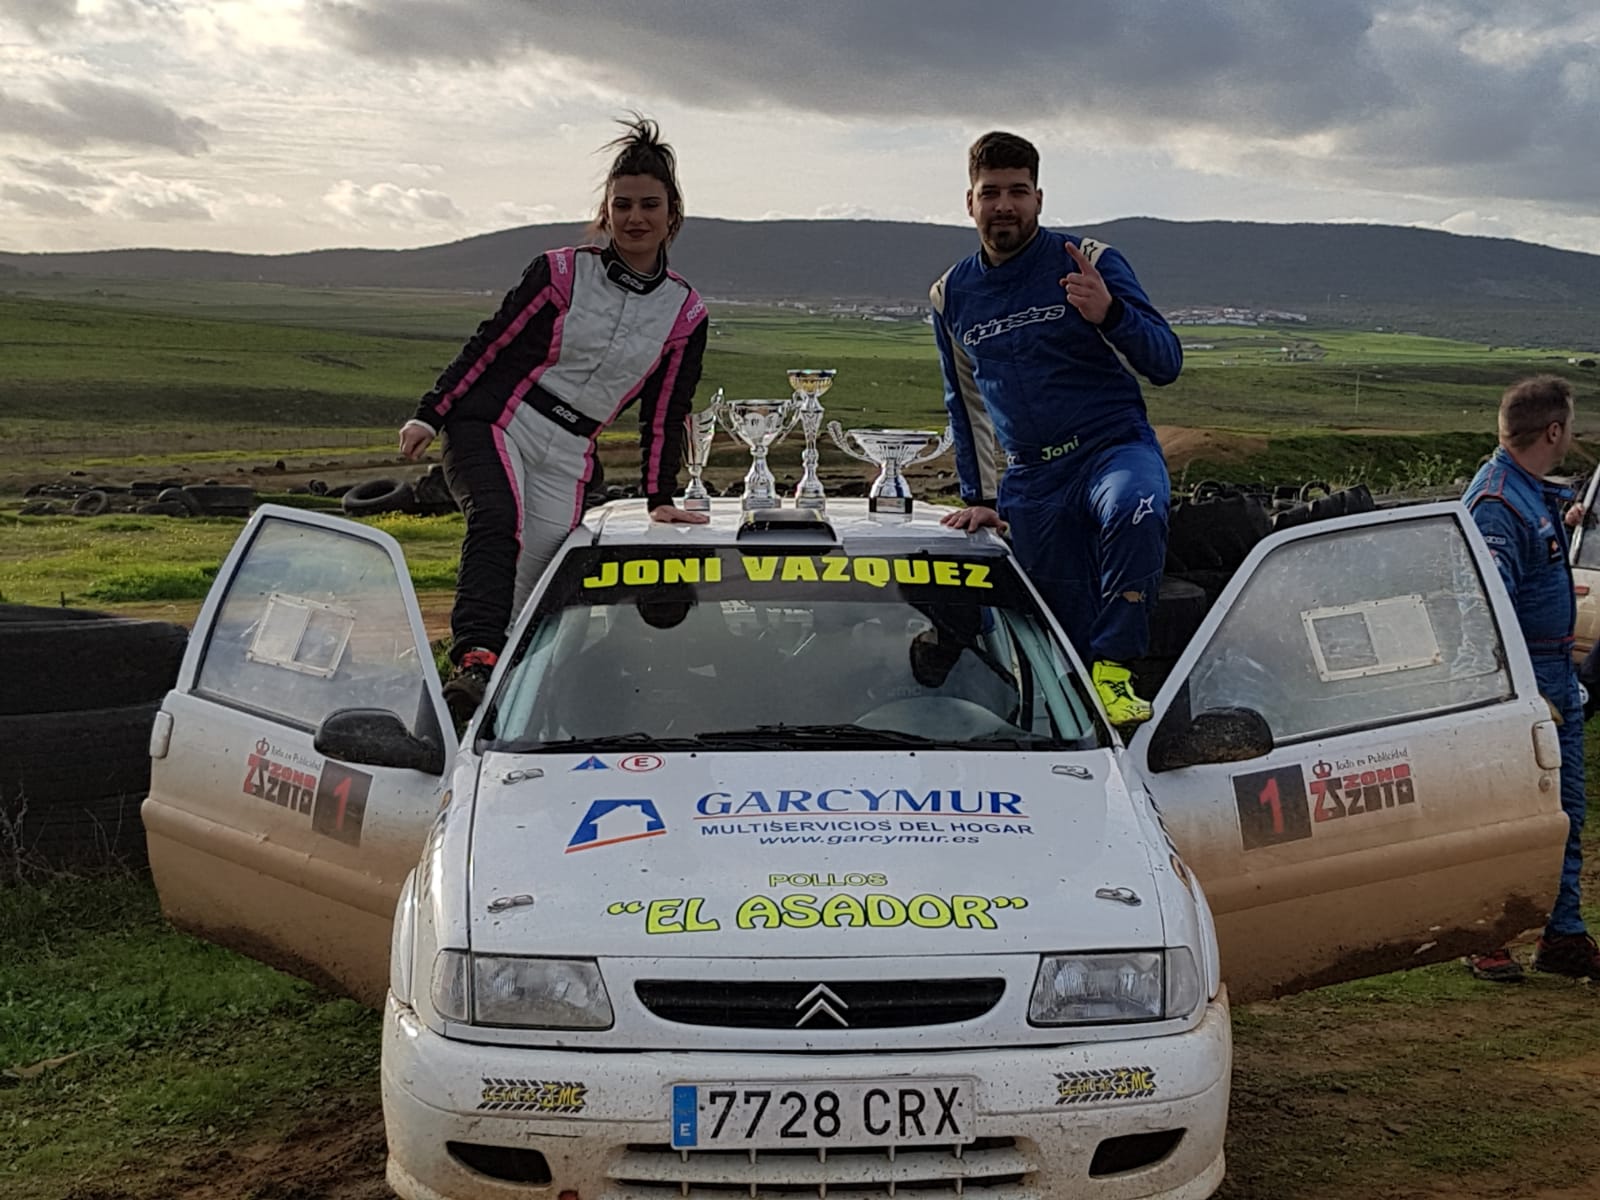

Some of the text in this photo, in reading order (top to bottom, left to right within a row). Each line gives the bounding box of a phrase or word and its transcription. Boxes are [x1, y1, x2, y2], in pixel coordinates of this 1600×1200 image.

[1041, 435, 1080, 461] Joni
[583, 556, 994, 589] JONI VAZQUEZ
[333, 776, 353, 832] 1
[696, 789, 1023, 815] GARCYMUR
[1259, 777, 1284, 833] 1
[701, 820, 1034, 835] MULTISERVICIOS DEL HOGAR
[759, 834, 980, 845] www.garcymur.es
[769, 873, 888, 887] POLLOS
[709, 1087, 961, 1139] 7728 CRX
[680, 1123, 691, 1136] E
